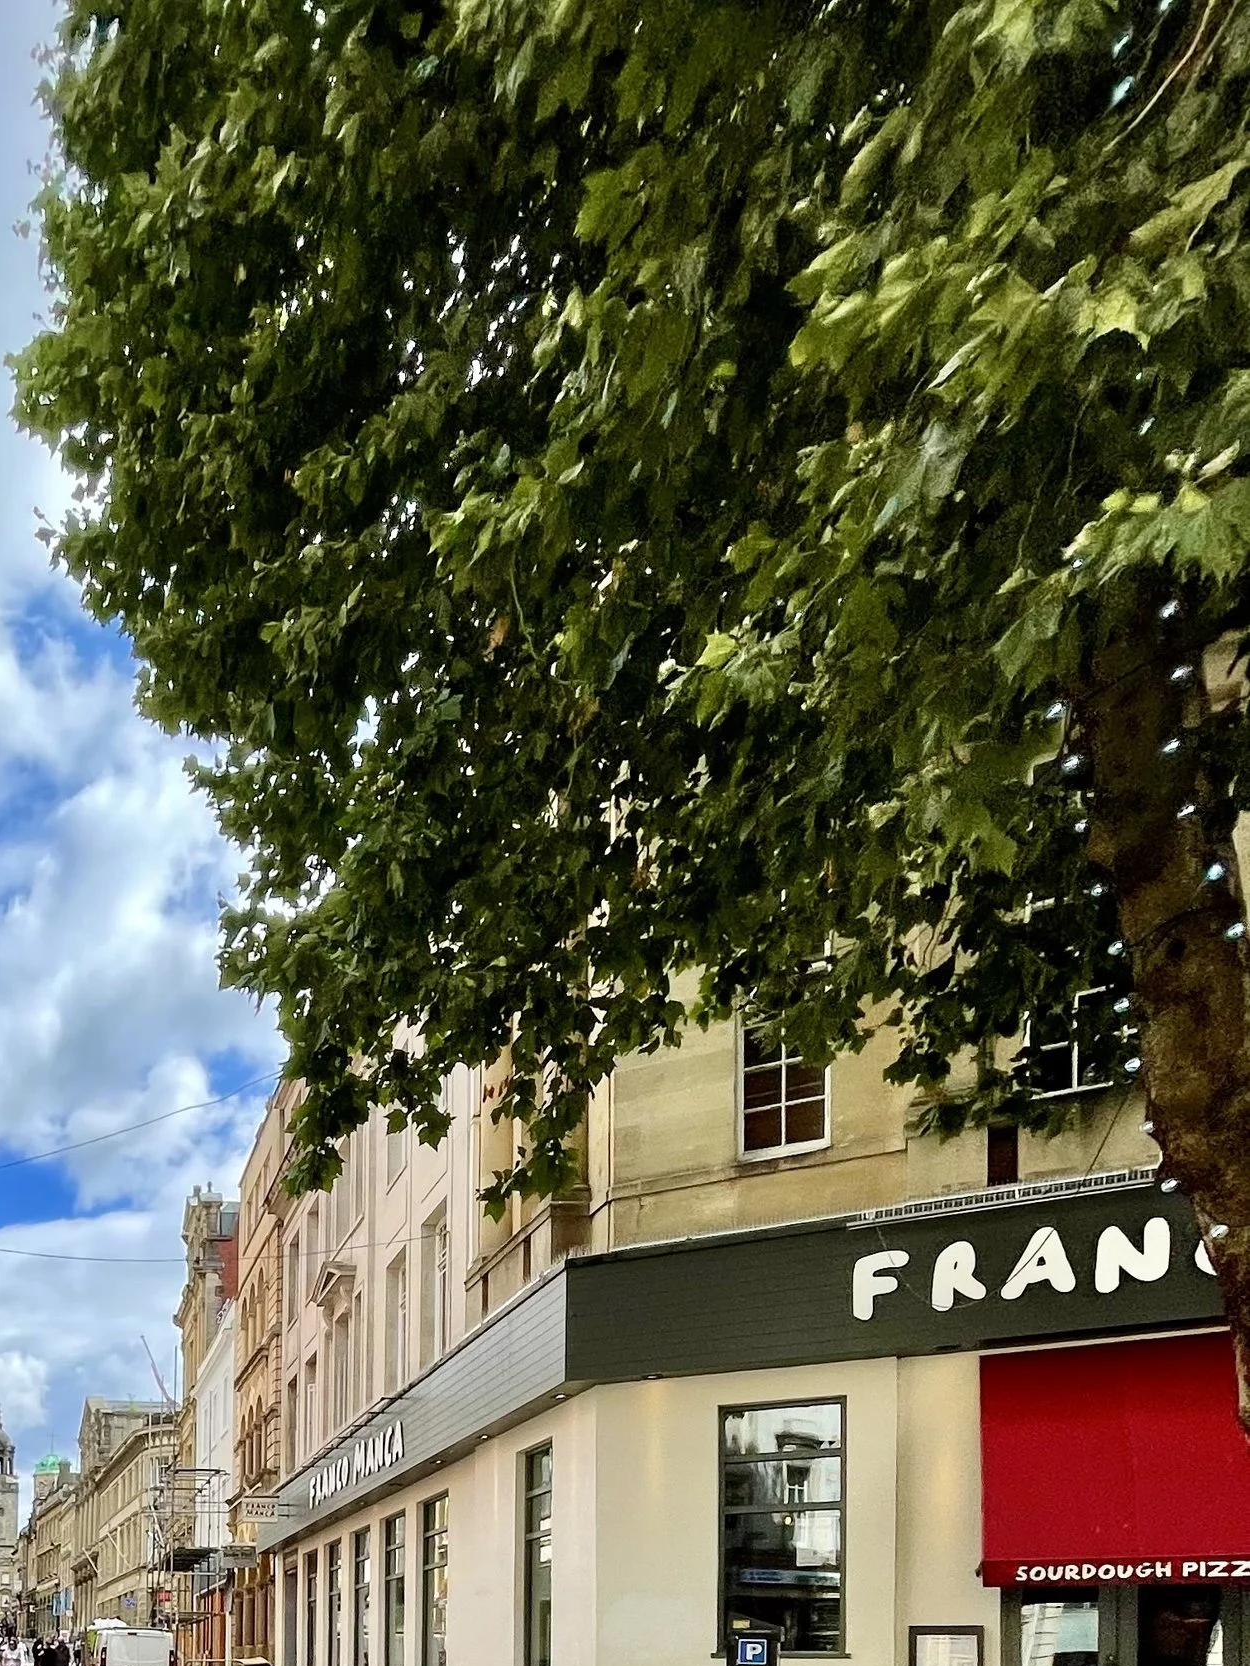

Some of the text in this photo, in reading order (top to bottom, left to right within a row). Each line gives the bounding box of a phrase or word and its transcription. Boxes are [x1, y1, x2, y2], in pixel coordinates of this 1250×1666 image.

[853, 1217, 1218, 1321] FRAN
[309, 1420, 404, 1509] FRANCO MANCA
[1015, 1560, 1250, 1581] SOURDOUGH PIZZ
[746, 1643, 763, 1660] P
